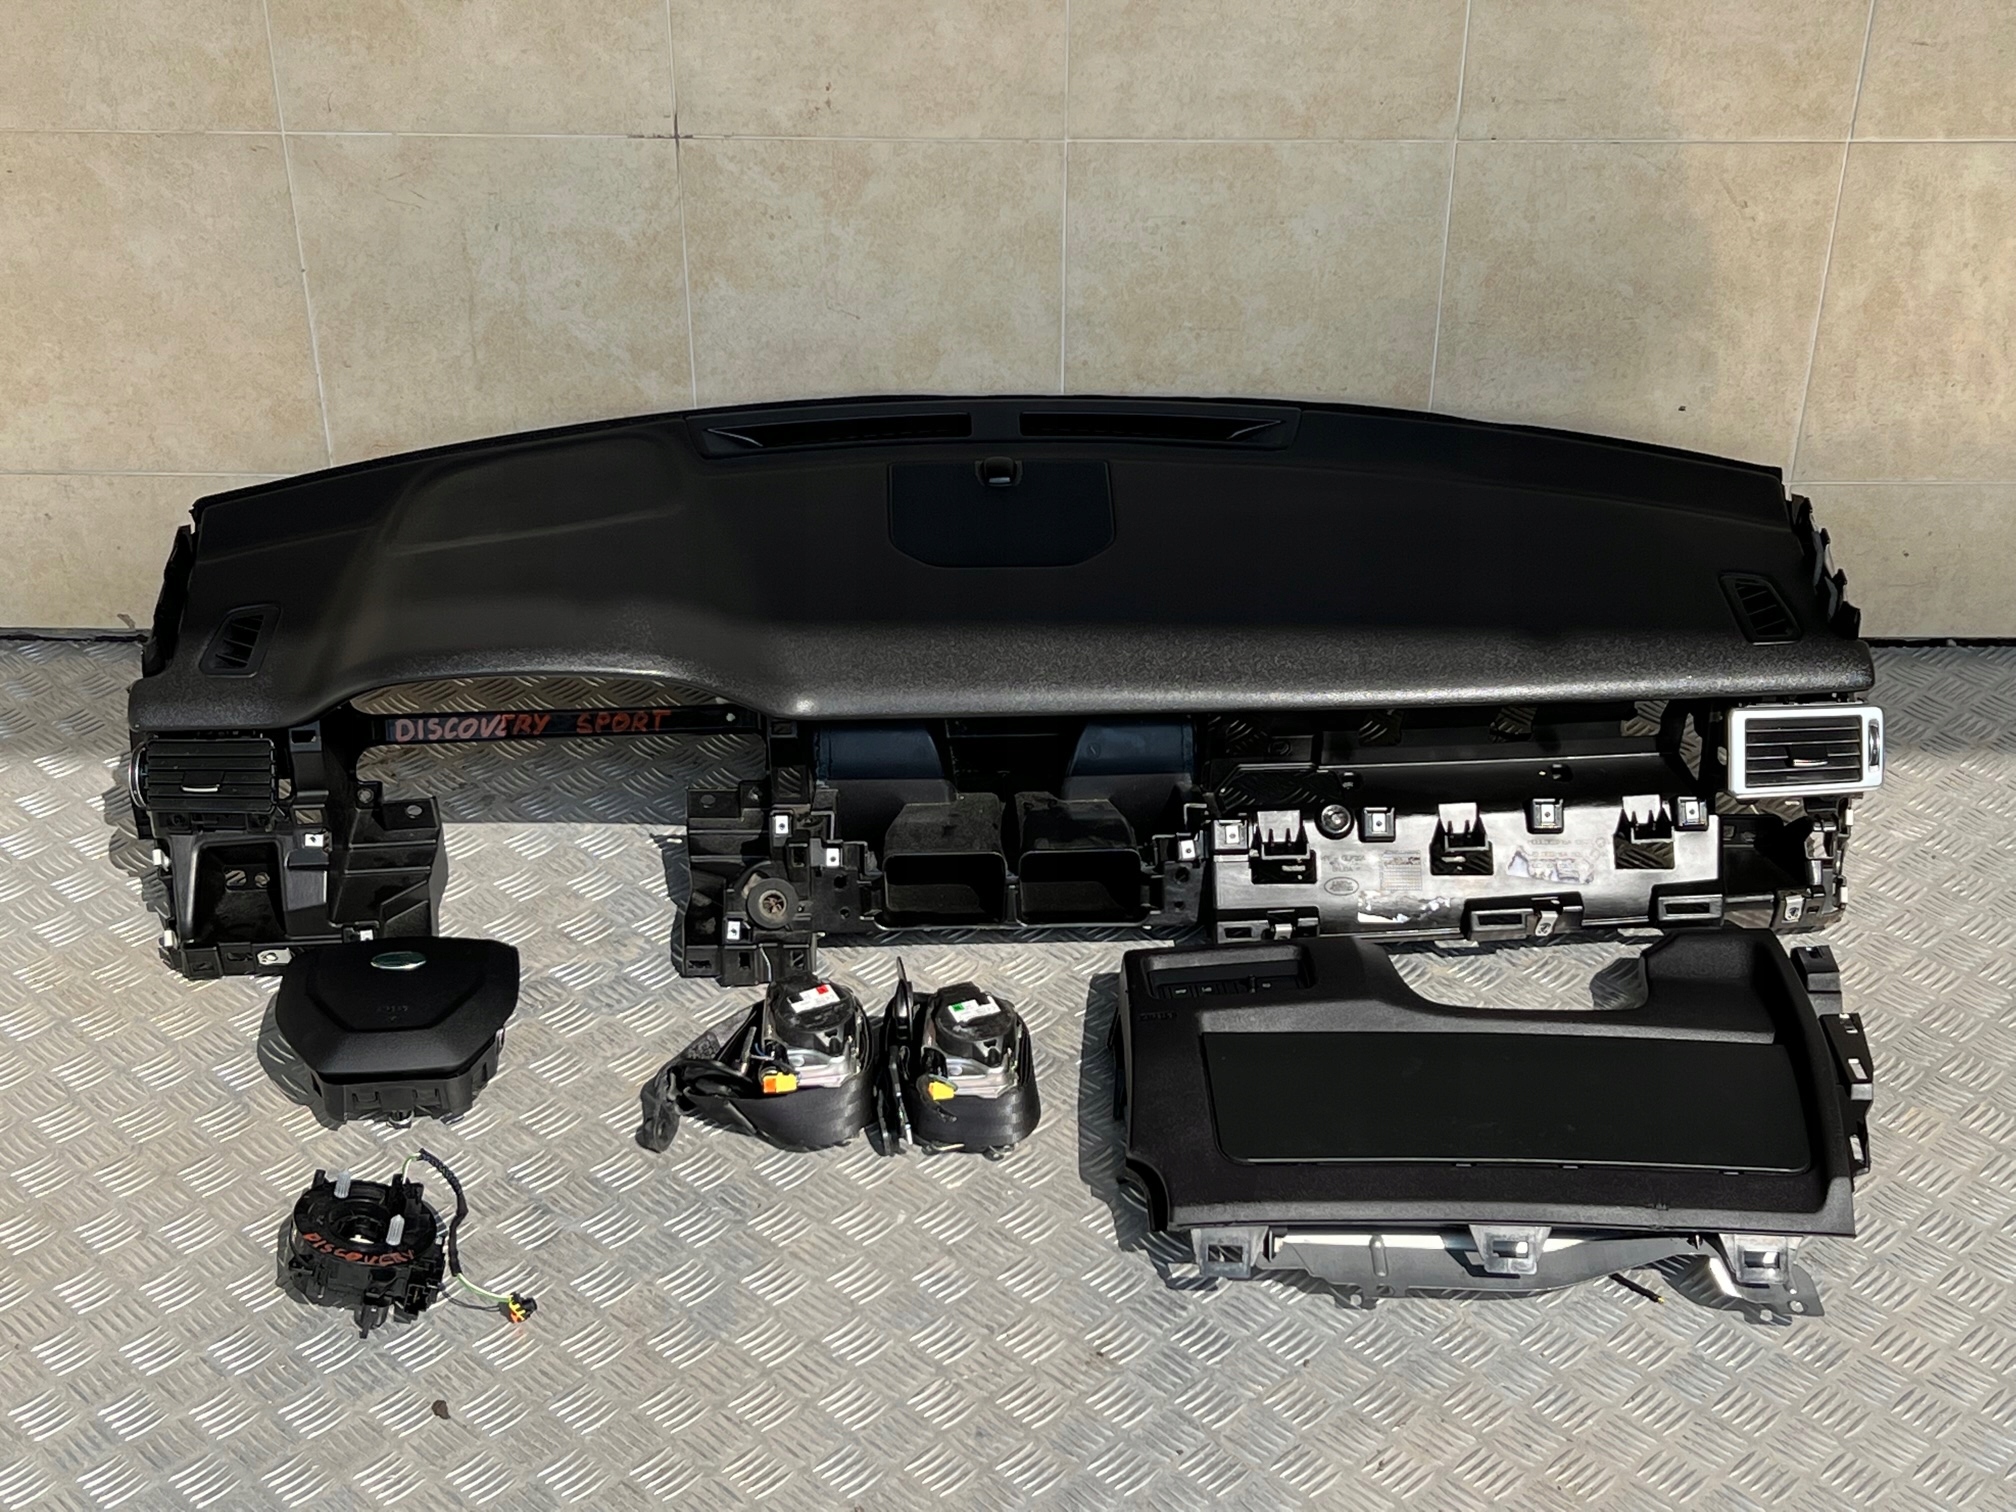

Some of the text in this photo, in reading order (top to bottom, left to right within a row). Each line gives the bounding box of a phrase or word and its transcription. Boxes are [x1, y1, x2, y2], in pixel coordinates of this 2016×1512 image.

[395, 709, 671, 742] DISCOVERY SPORT
[303, 1233, 415, 1267] DISCOVERY
